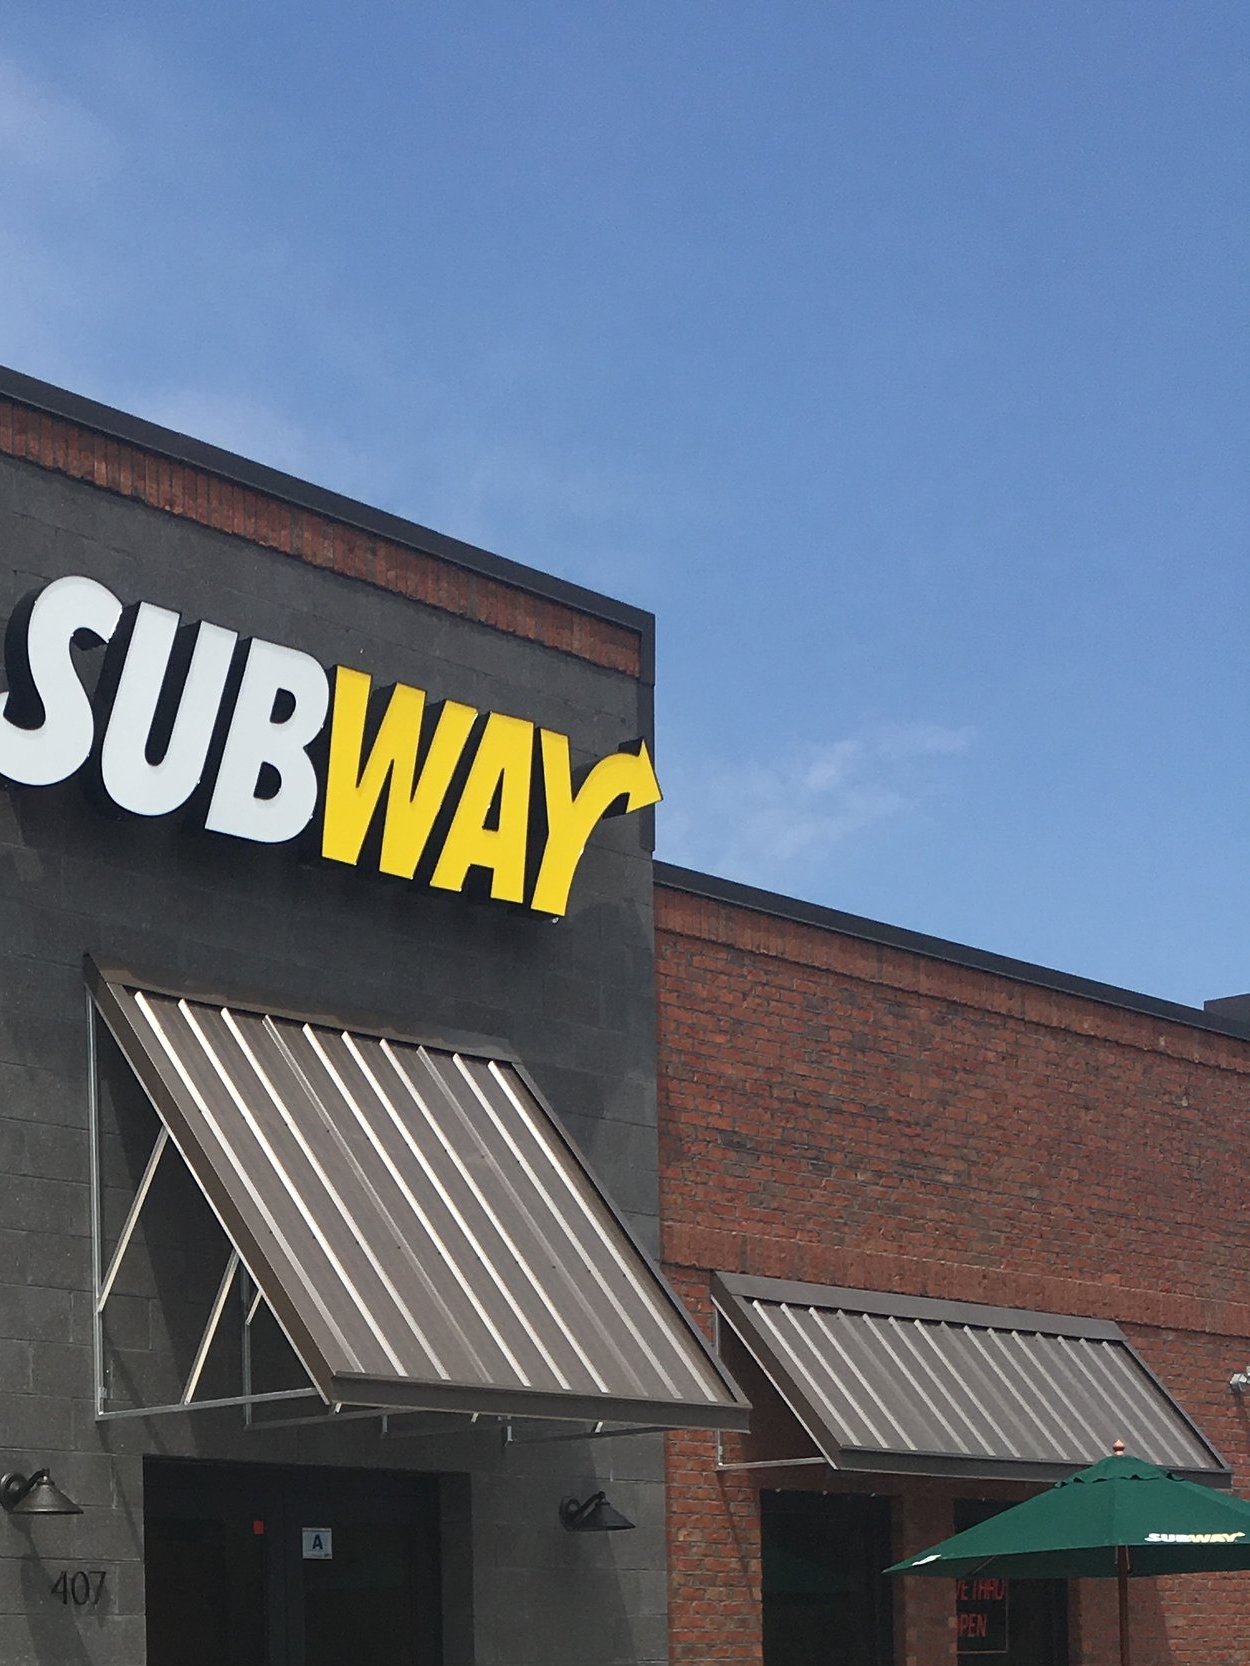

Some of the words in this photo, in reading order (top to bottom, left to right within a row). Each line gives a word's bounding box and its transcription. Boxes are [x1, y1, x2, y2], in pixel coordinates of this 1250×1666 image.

[312, 1533, 323, 1550] A
[1144, 1531, 1246, 1543] SUBWAY
[51, 1570, 106, 1605] 407
[957, 1614, 987, 1637] PEN
